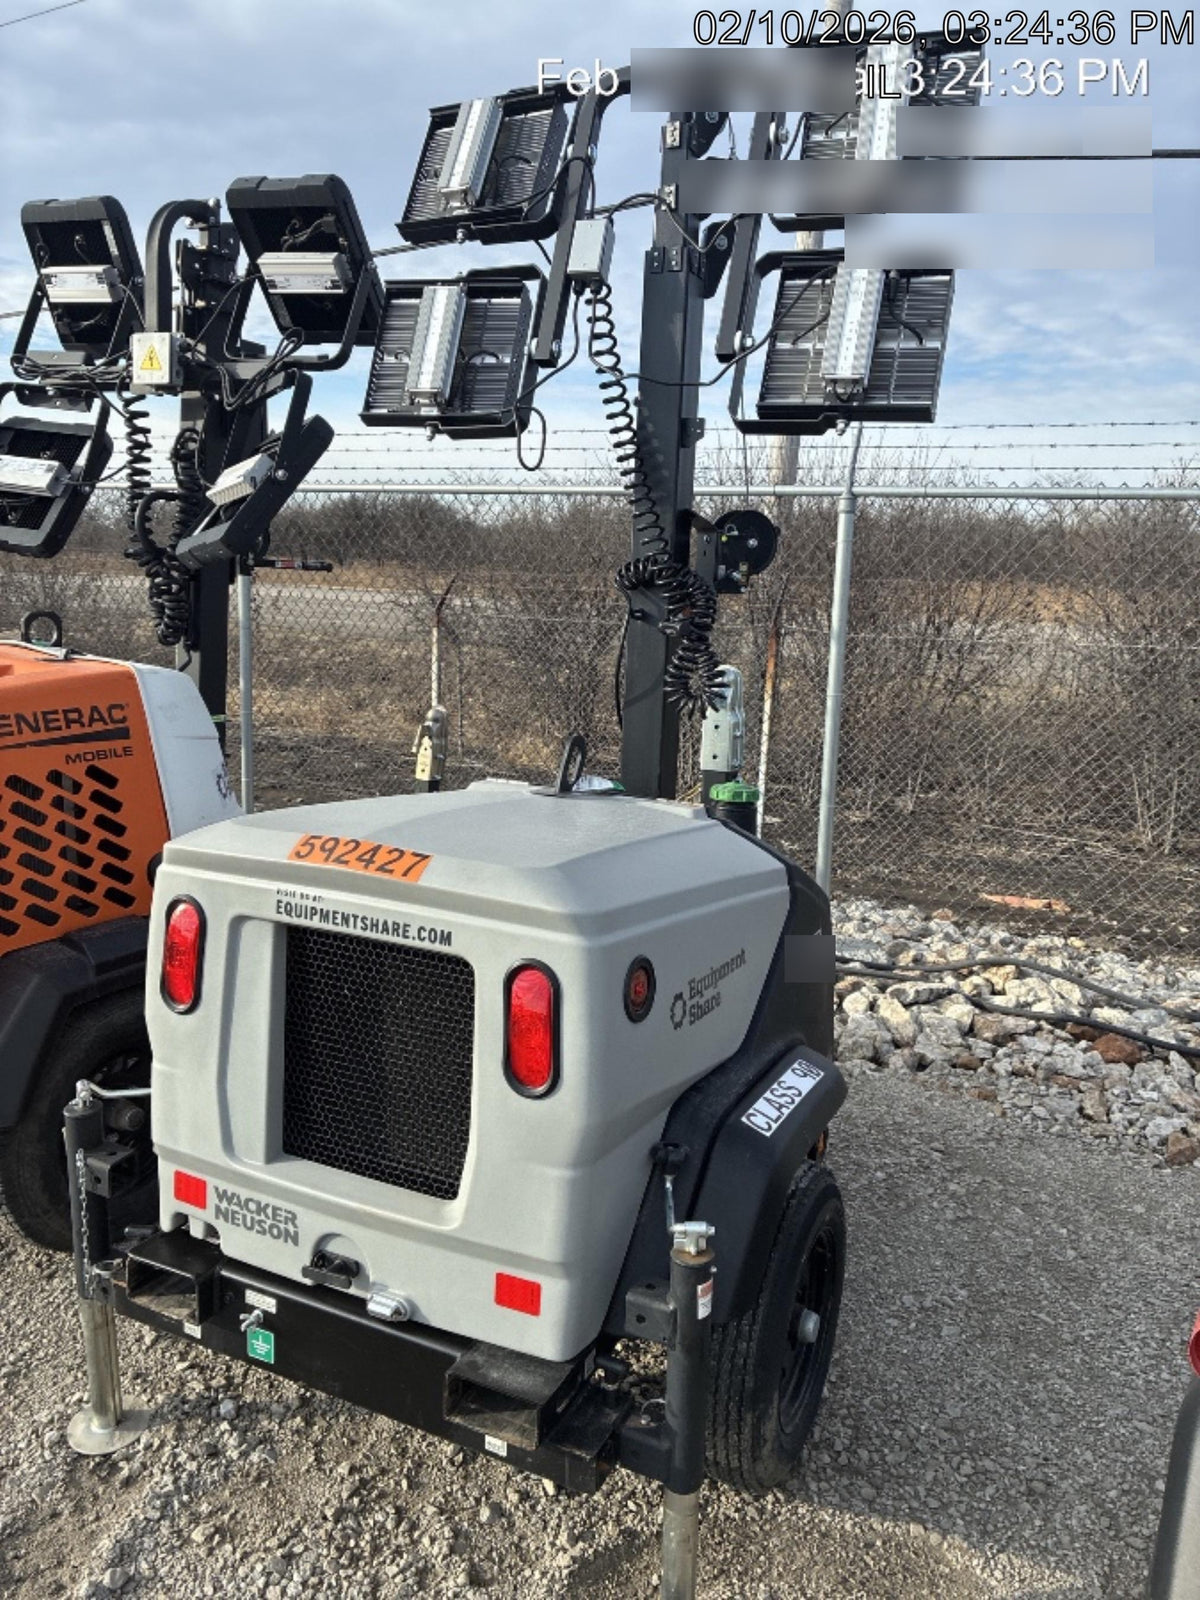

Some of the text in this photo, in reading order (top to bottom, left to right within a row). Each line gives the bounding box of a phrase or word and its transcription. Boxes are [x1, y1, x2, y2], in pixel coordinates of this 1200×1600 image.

[65, 746, 134, 765] MOBILE
[294, 835, 430, 878] 592427
[275, 899, 453, 947] EQUIPMENTSHARE.COM
[688, 948, 747, 1000] Equipment
[688, 991, 722, 1027] Share
[746, 1080, 803, 1135] CLASS
[213, 1186, 299, 1229] WACKER
[213, 1203, 299, 1247] NEUSON
